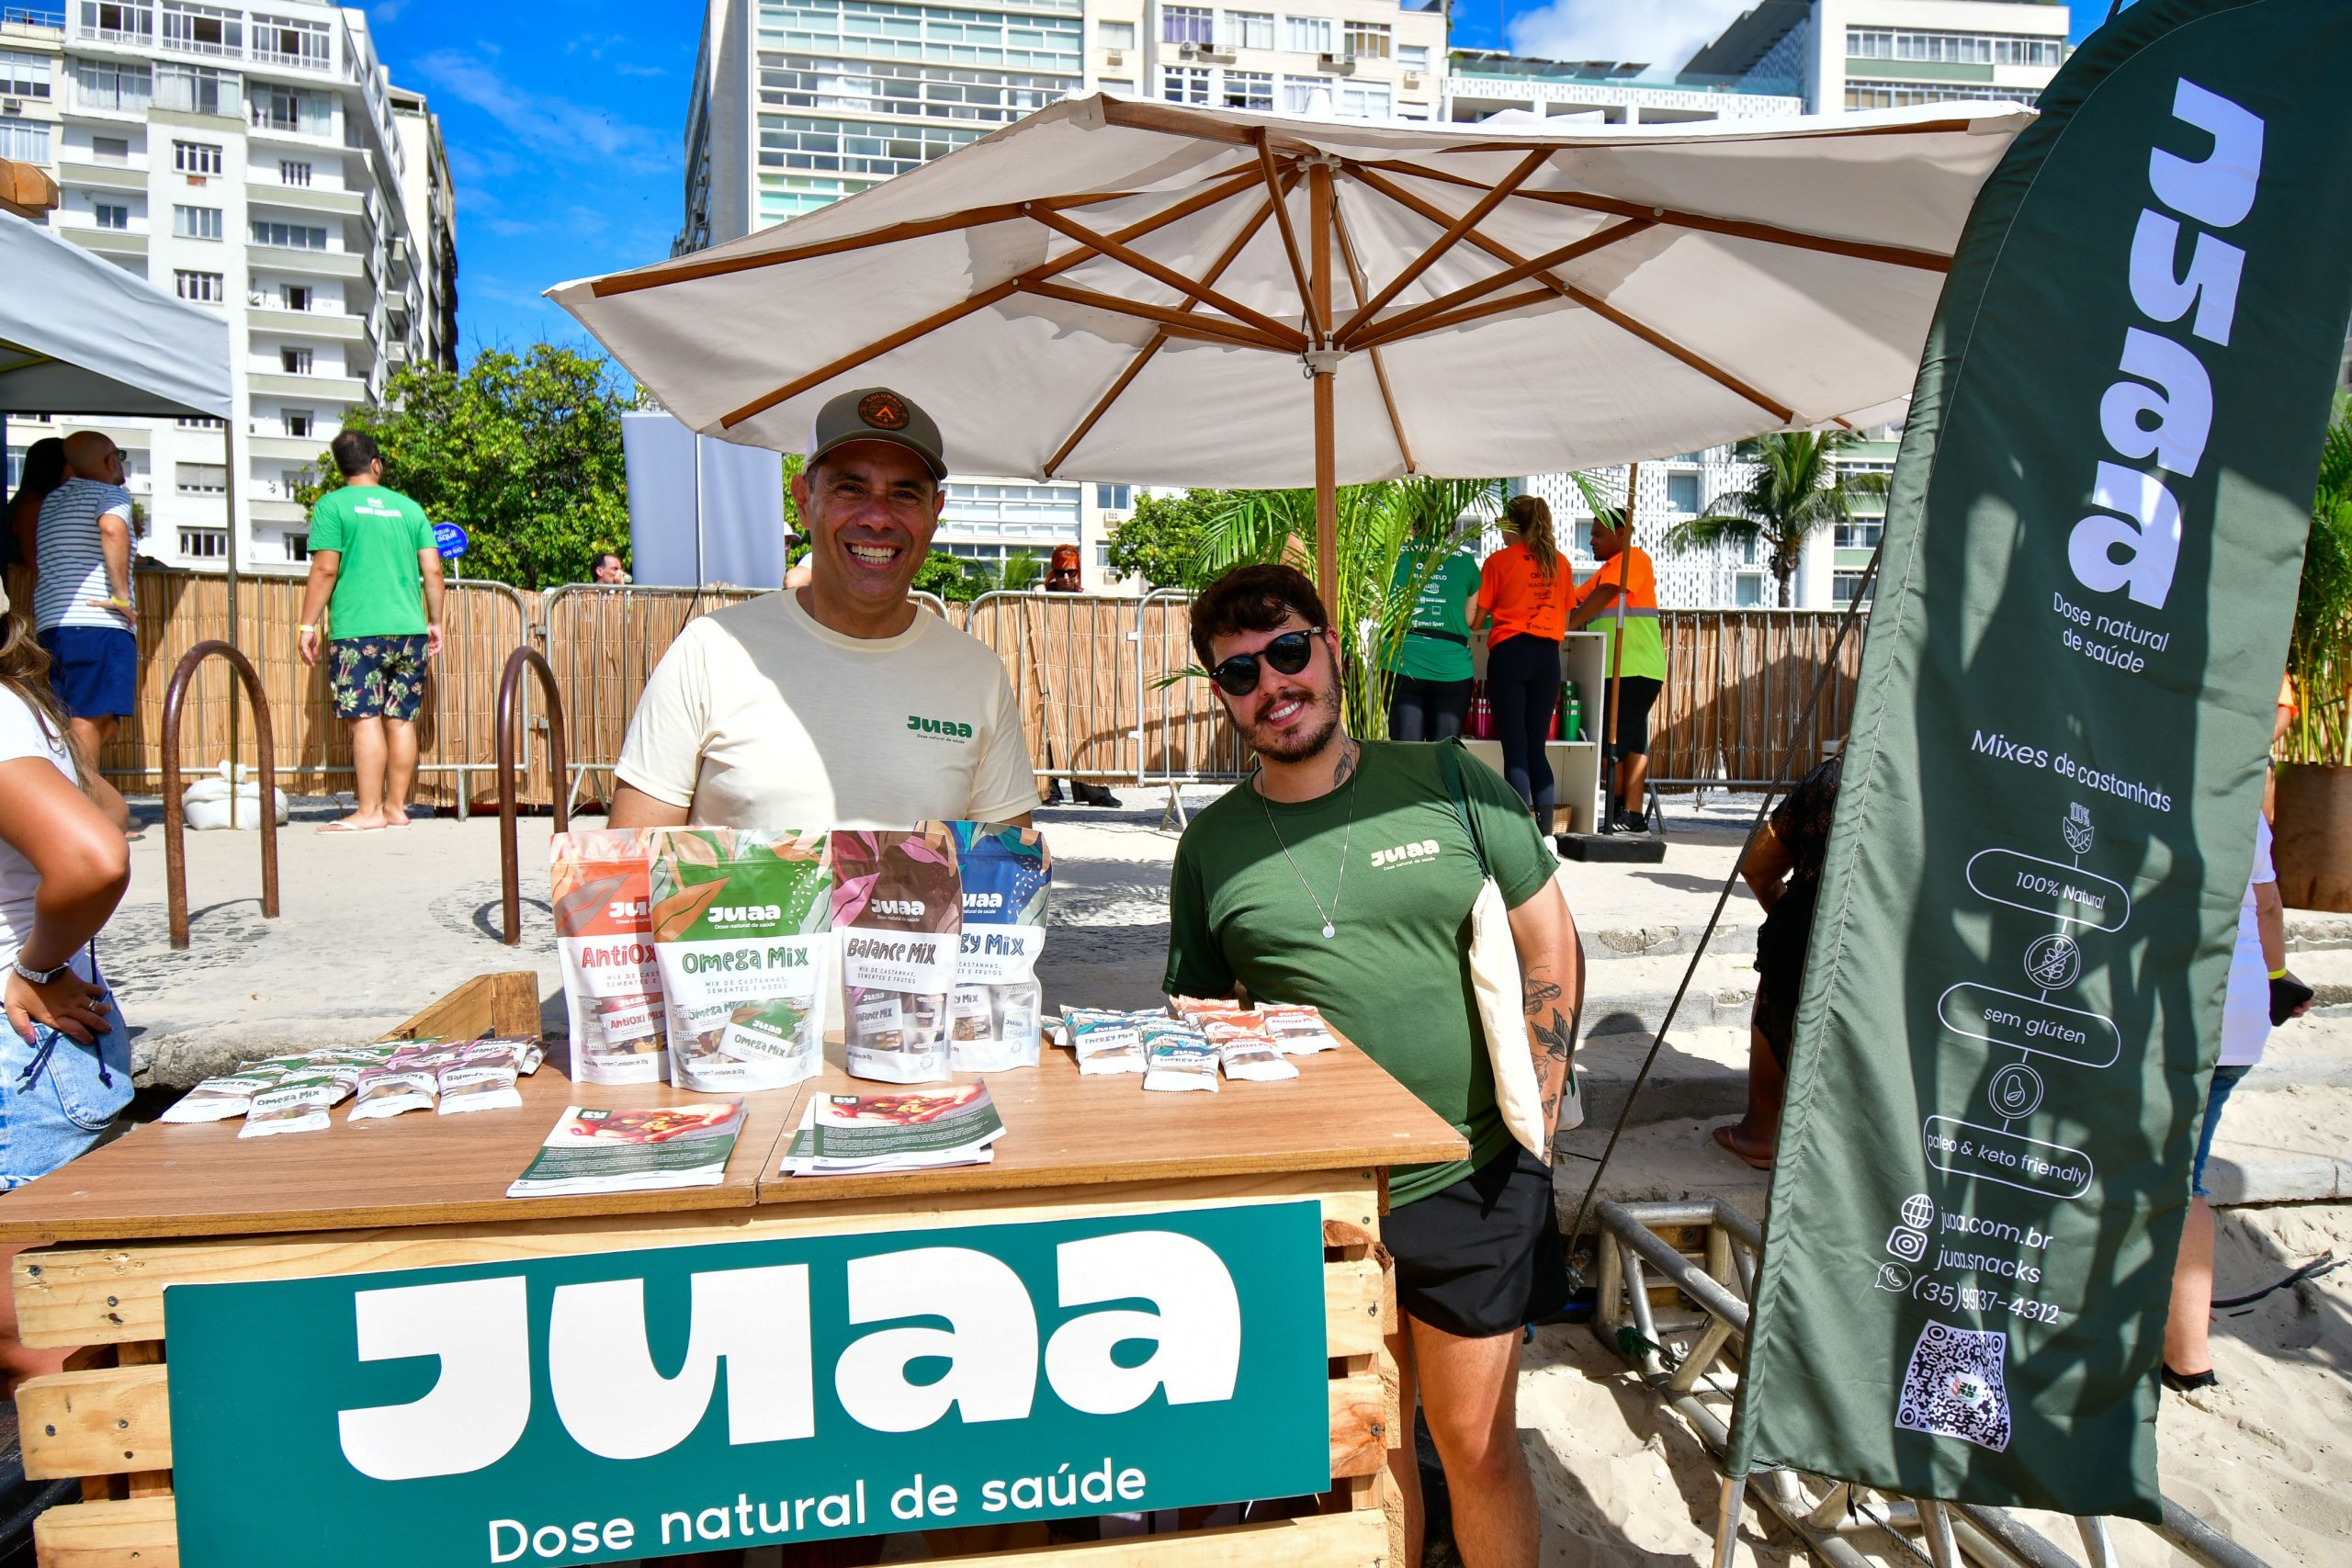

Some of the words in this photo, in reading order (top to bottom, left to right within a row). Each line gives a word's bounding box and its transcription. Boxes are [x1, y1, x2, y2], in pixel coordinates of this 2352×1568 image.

[2053, 592, 2091, 626] Dose
[2096, 615, 2169, 652] natural
[2064, 627, 2082, 651] de
[2085, 641, 2144, 673] saúde
[1971, 729, 2049, 769] Mixes
[2054, 752, 2075, 778] de
[2077, 766, 2172, 813] castanhas
[962, 893, 1002, 908] uaa
[2016, 872, 2059, 897] 100%
[2063, 885, 2106, 909] Natural
[582, 943, 657, 968] AntiOx
[682, 948, 761, 974] Omega
[846, 938, 906, 962] Balance
[707, 986, 749, 994] SEMENTES
[734, 1033, 767, 1051] Omega
[1984, 1008, 2020, 1028] sem
[2025, 1020, 2086, 1044] glúten
[256, 1094, 296, 1106] Omega
[1928, 1134, 1957, 1153] paleo
[1961, 1141, 1973, 1156] &
[1977, 1145, 2016, 1167] keto
[2020, 1155, 2086, 1187] friendly
[1940, 1206, 2053, 1250] juaa.com.br
[1934, 1244, 2041, 1283] juaa.snacks
[487, 1516, 635, 1563] Dose
[660, 1480, 865, 1545] natural
[890, 1473, 958, 1519] de
[981, 1458, 1147, 1514] saúde
